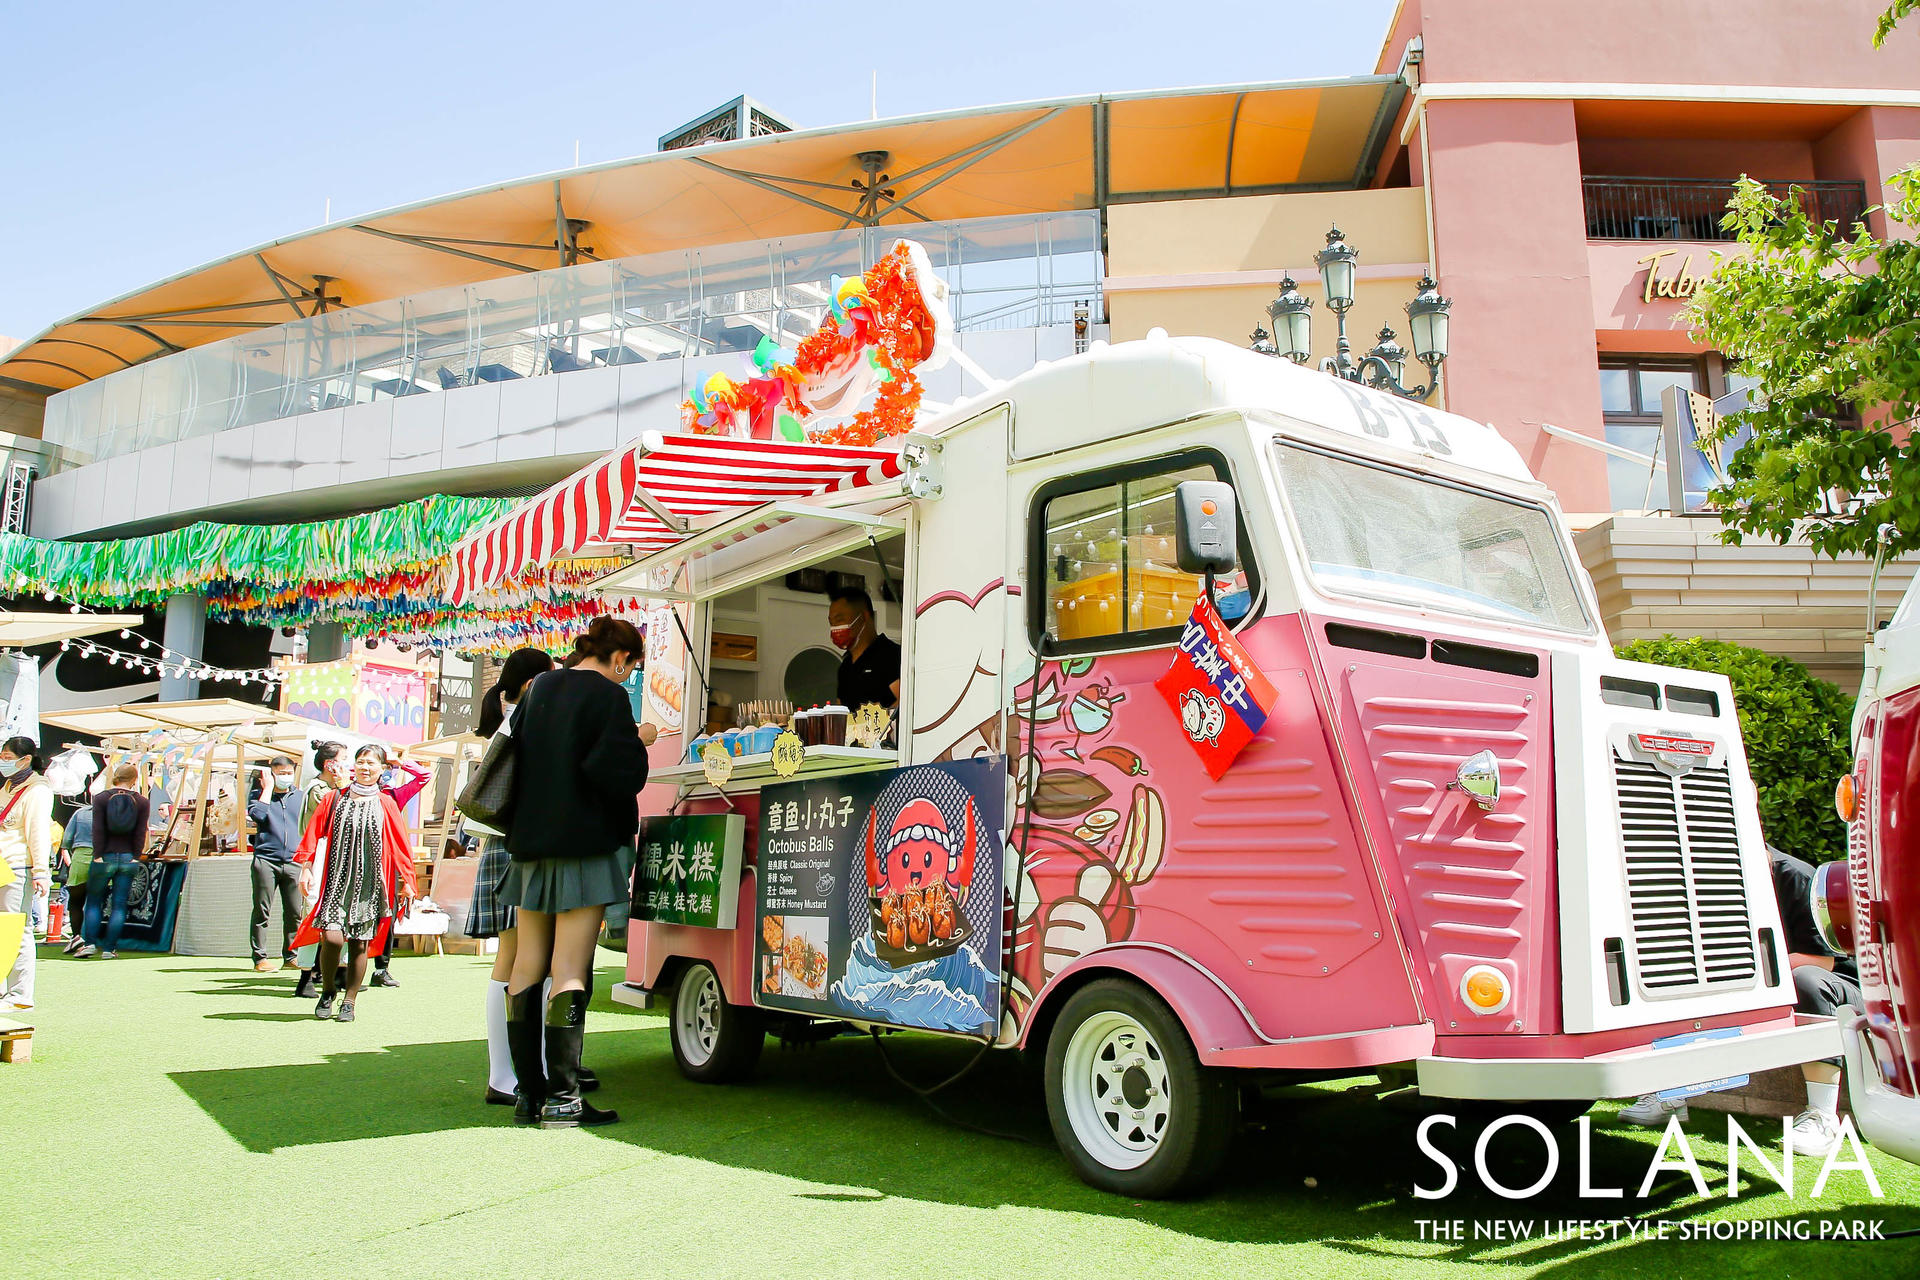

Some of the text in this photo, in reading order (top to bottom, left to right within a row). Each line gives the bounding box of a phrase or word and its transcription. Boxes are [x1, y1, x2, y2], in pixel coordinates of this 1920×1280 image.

[767, 795, 855, 834] 章鱼小丸子
[768, 835, 834, 854] Octobus Balls
[789, 859, 808, 869] Classic
[808, 859, 831, 870] Original
[767, 873, 794, 884] 香辣 Spicy
[767, 886, 798, 896] 芝士 Cheese
[787, 899, 803, 910] Honey
[804, 899, 827, 909] Mustard
